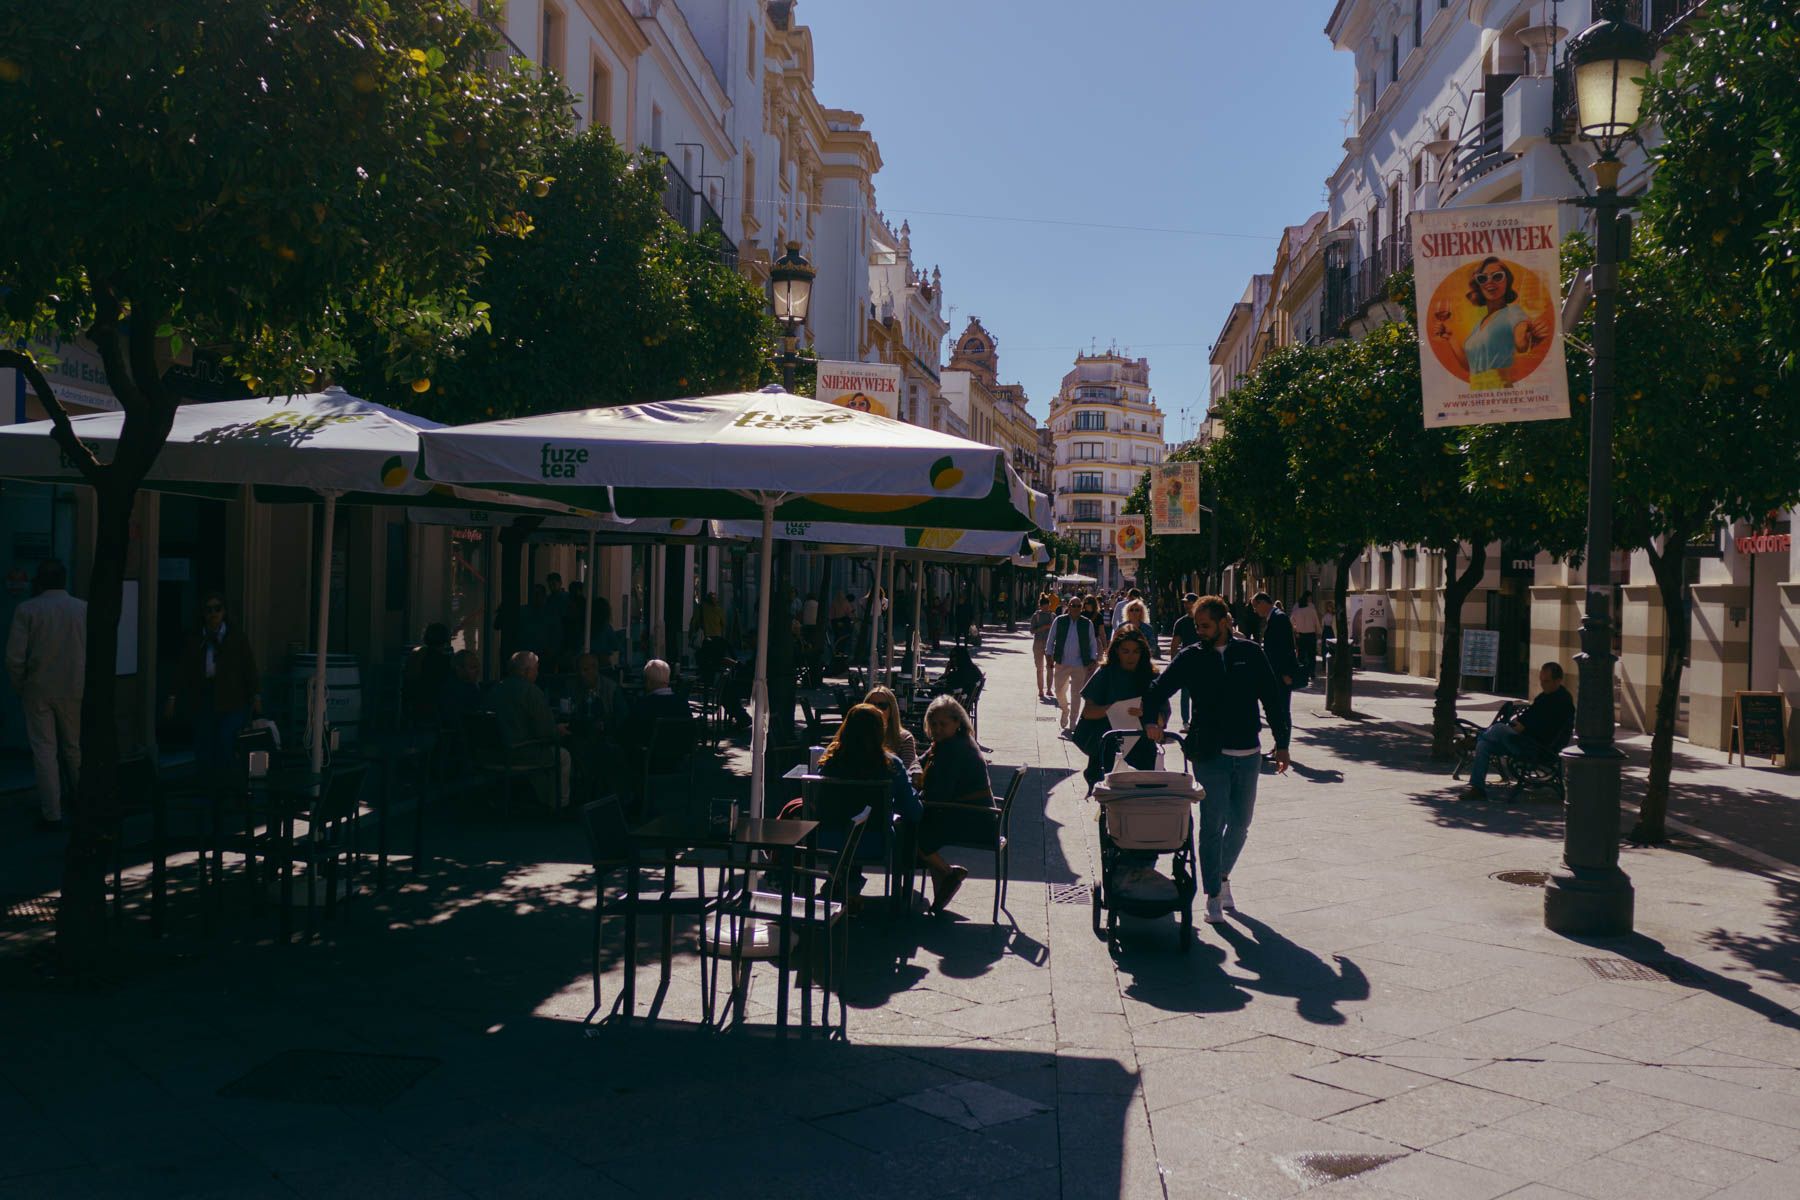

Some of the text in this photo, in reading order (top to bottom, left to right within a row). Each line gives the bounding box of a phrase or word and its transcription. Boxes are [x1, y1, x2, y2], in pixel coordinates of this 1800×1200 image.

[1471, 220, 1493, 228] NOV
[1496, 218, 1519, 227] 2025
[63, 357, 78, 378] del
[81, 362, 107, 384] Esta
[541, 443, 589, 463] fuze
[541, 462, 576, 478] tea
[785, 525, 805, 536] tea
[1736, 528, 1792, 554] vodafone
[1370, 607, 1385, 616] 2x1
